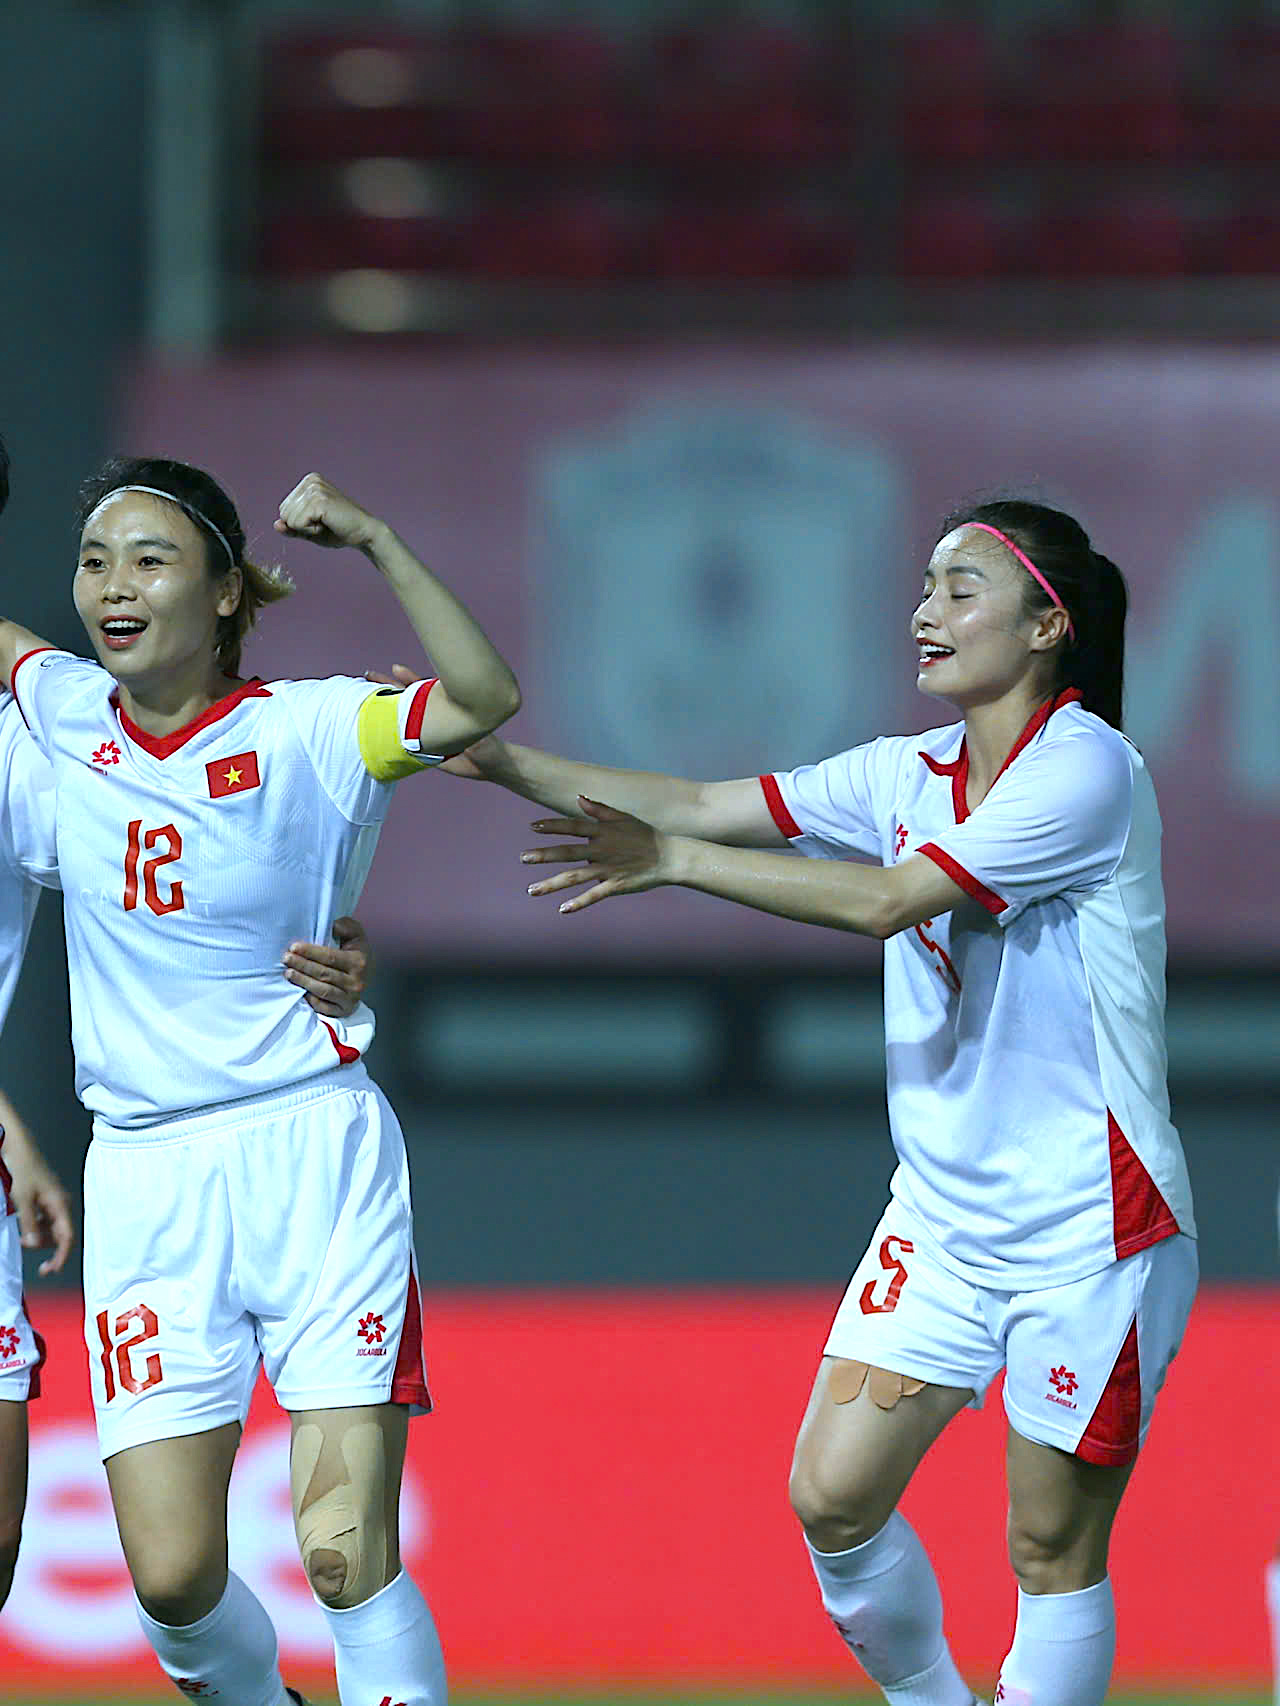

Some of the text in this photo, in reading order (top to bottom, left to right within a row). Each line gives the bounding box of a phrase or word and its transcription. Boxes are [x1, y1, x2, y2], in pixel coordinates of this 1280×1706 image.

[123, 820, 185, 917] 12
[859, 1235, 914, 1315] 5
[96, 1303, 163, 1403] 12
